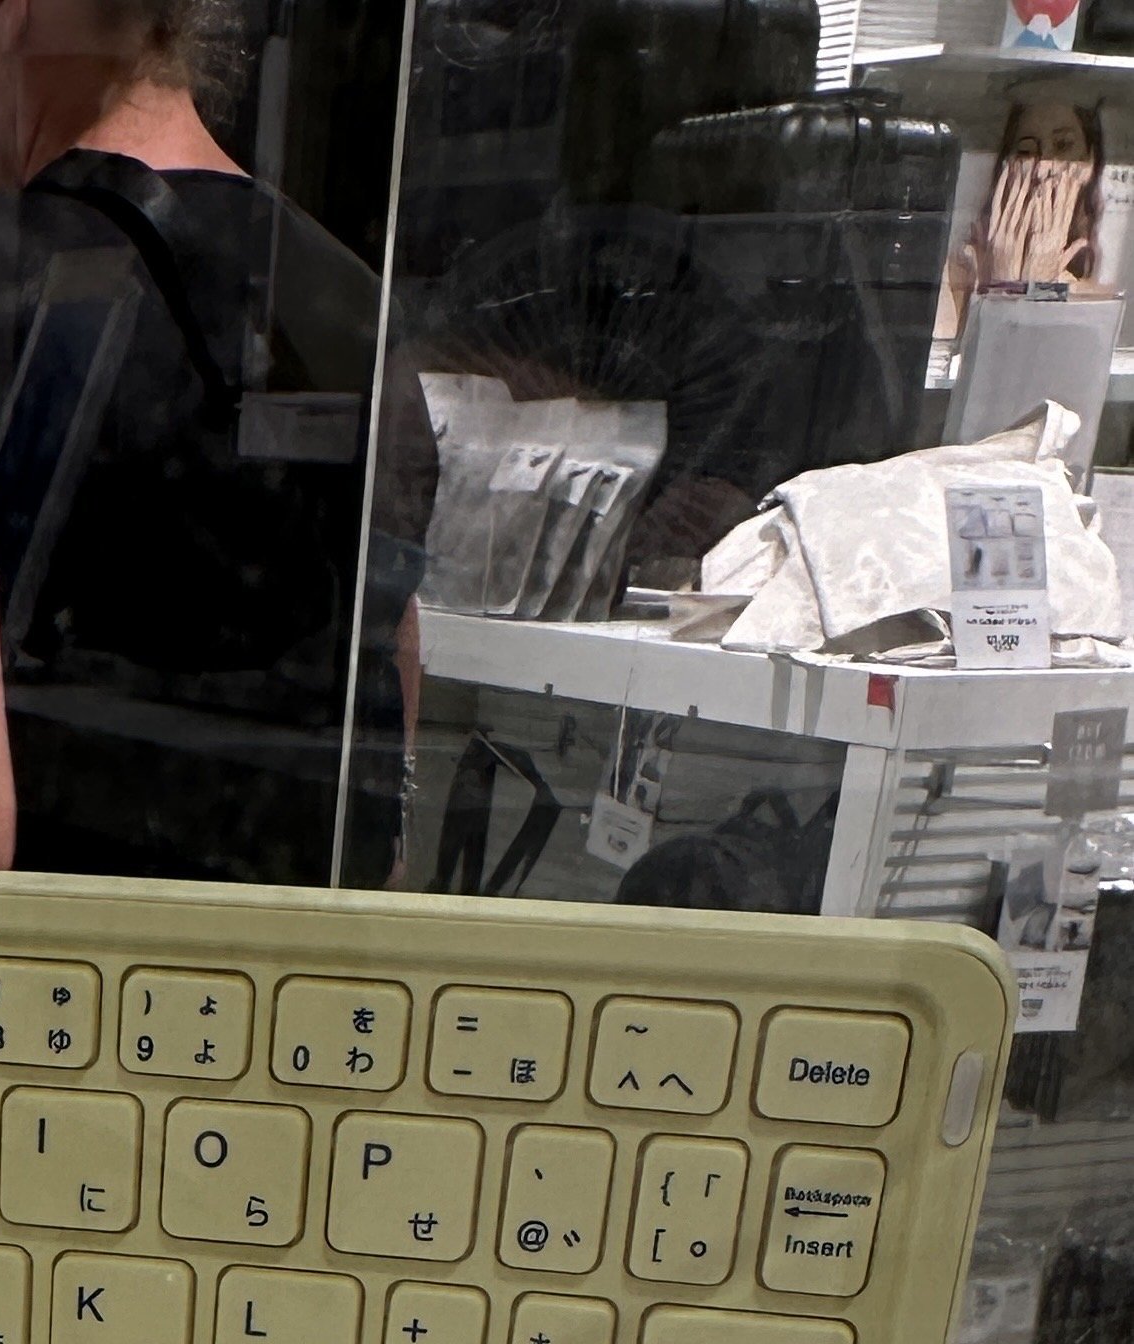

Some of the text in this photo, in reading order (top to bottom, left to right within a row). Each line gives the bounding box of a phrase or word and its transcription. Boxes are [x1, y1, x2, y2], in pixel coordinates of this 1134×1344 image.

[352, 1006, 376, 1034] を
[47, 1028, 72, 1055] ゆ
[136, 1035, 217, 1065] 9 よ
[345, 1045, 374, 1074] わ
[509, 1057, 537, 1085] ほ
[788, 1057, 871, 1087] Delete
[193, 1130, 228, 1169] O
[361, 1142, 393, 1181] P
[79, 1183, 106, 1213] に
[245, 1195, 269, 1227] ら
[407, 1212, 439, 1242] せ
[516, 1219, 549, 1253] @
[784, 1234, 854, 1259] Insert
[76, 1285, 106, 1323] K
[244, 1300, 268, 1338] L
[401, 1318, 428, 1344] +
